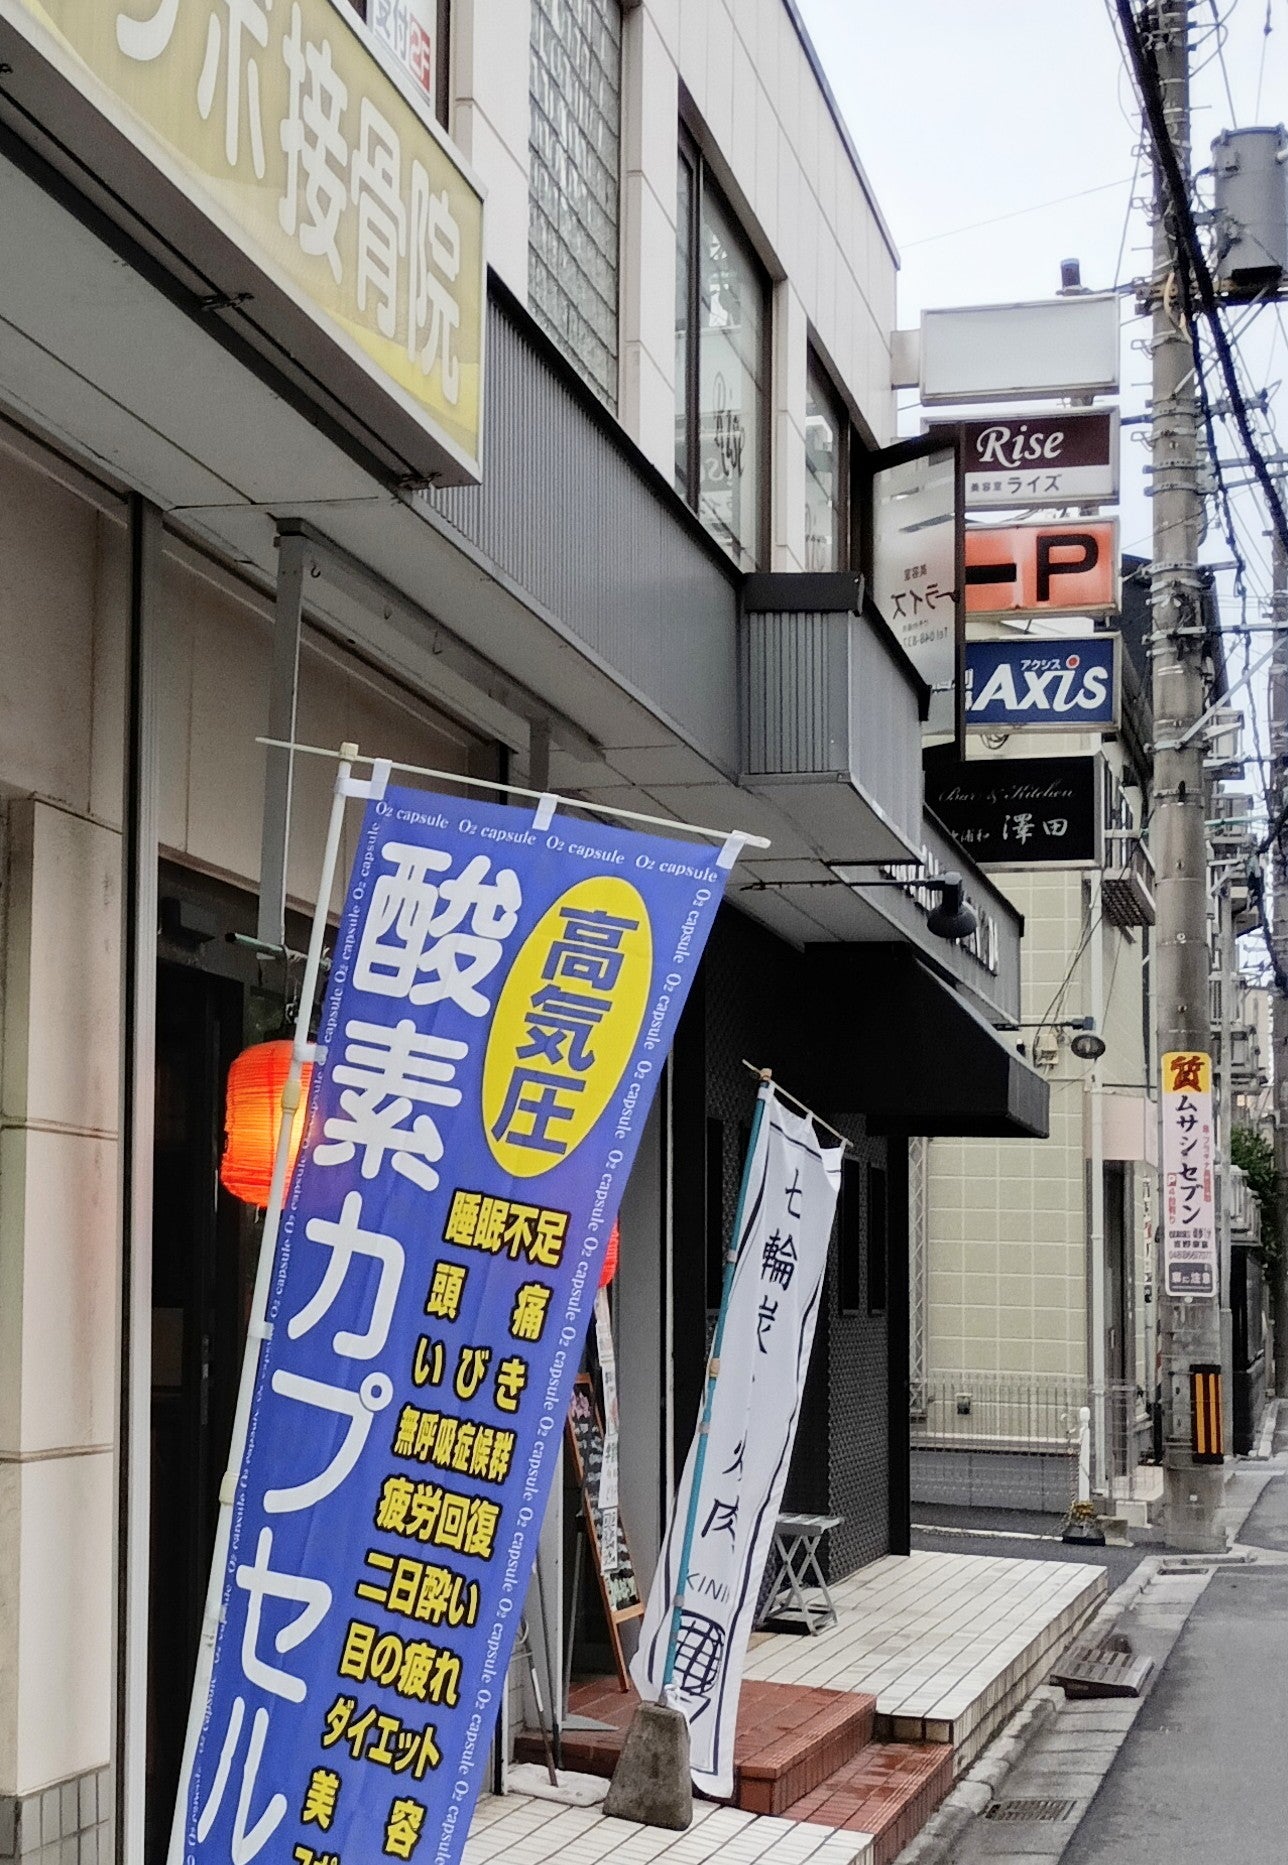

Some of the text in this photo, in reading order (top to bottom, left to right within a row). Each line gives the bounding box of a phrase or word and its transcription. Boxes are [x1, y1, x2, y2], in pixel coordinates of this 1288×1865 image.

[977, 425, 1064, 468] Rise
[1007, 474, 1062, 494] ライズ
[1036, 533, 1099, 602] P
[361, 822, 380, 877] capsule
[396, 808, 449, 829] capsule
[480, 826, 537, 846] capsule
[569, 843, 625, 864] capsule
[659, 861, 718, 883] capsule
[673, 910, 699, 963] capsule
[491, 907, 640, 1156] 高気圧
[644, 995, 670, 1050] capsule
[1170, 1055, 1205, 1092] 質
[615, 1083, 641, 1140] capsule
[445, 1191, 569, 1265] 睡眠不足
[588, 1173, 612, 1232] capsule
[565, 1261, 589, 1321] capsule
[197, 841, 522, 1865] 酸素カプセル
[543, 1350, 566, 1410] capsule
[393, 1406, 515, 1481] 無呼吸症候群
[523, 1441, 545, 1501] capsule
[377, 1478, 500, 1557] 疲労回復
[358, 1552, 481, 1625] 二日酔い
[502, 1532, 524, 1592] capsule
[341, 1622, 462, 1705] 目の疲れ
[481, 1622, 504, 1683] capsule
[322, 1698, 441, 1777] ダイエット
[459, 1713, 482, 1775] capsule
[434, 1805, 459, 1865] capsule
